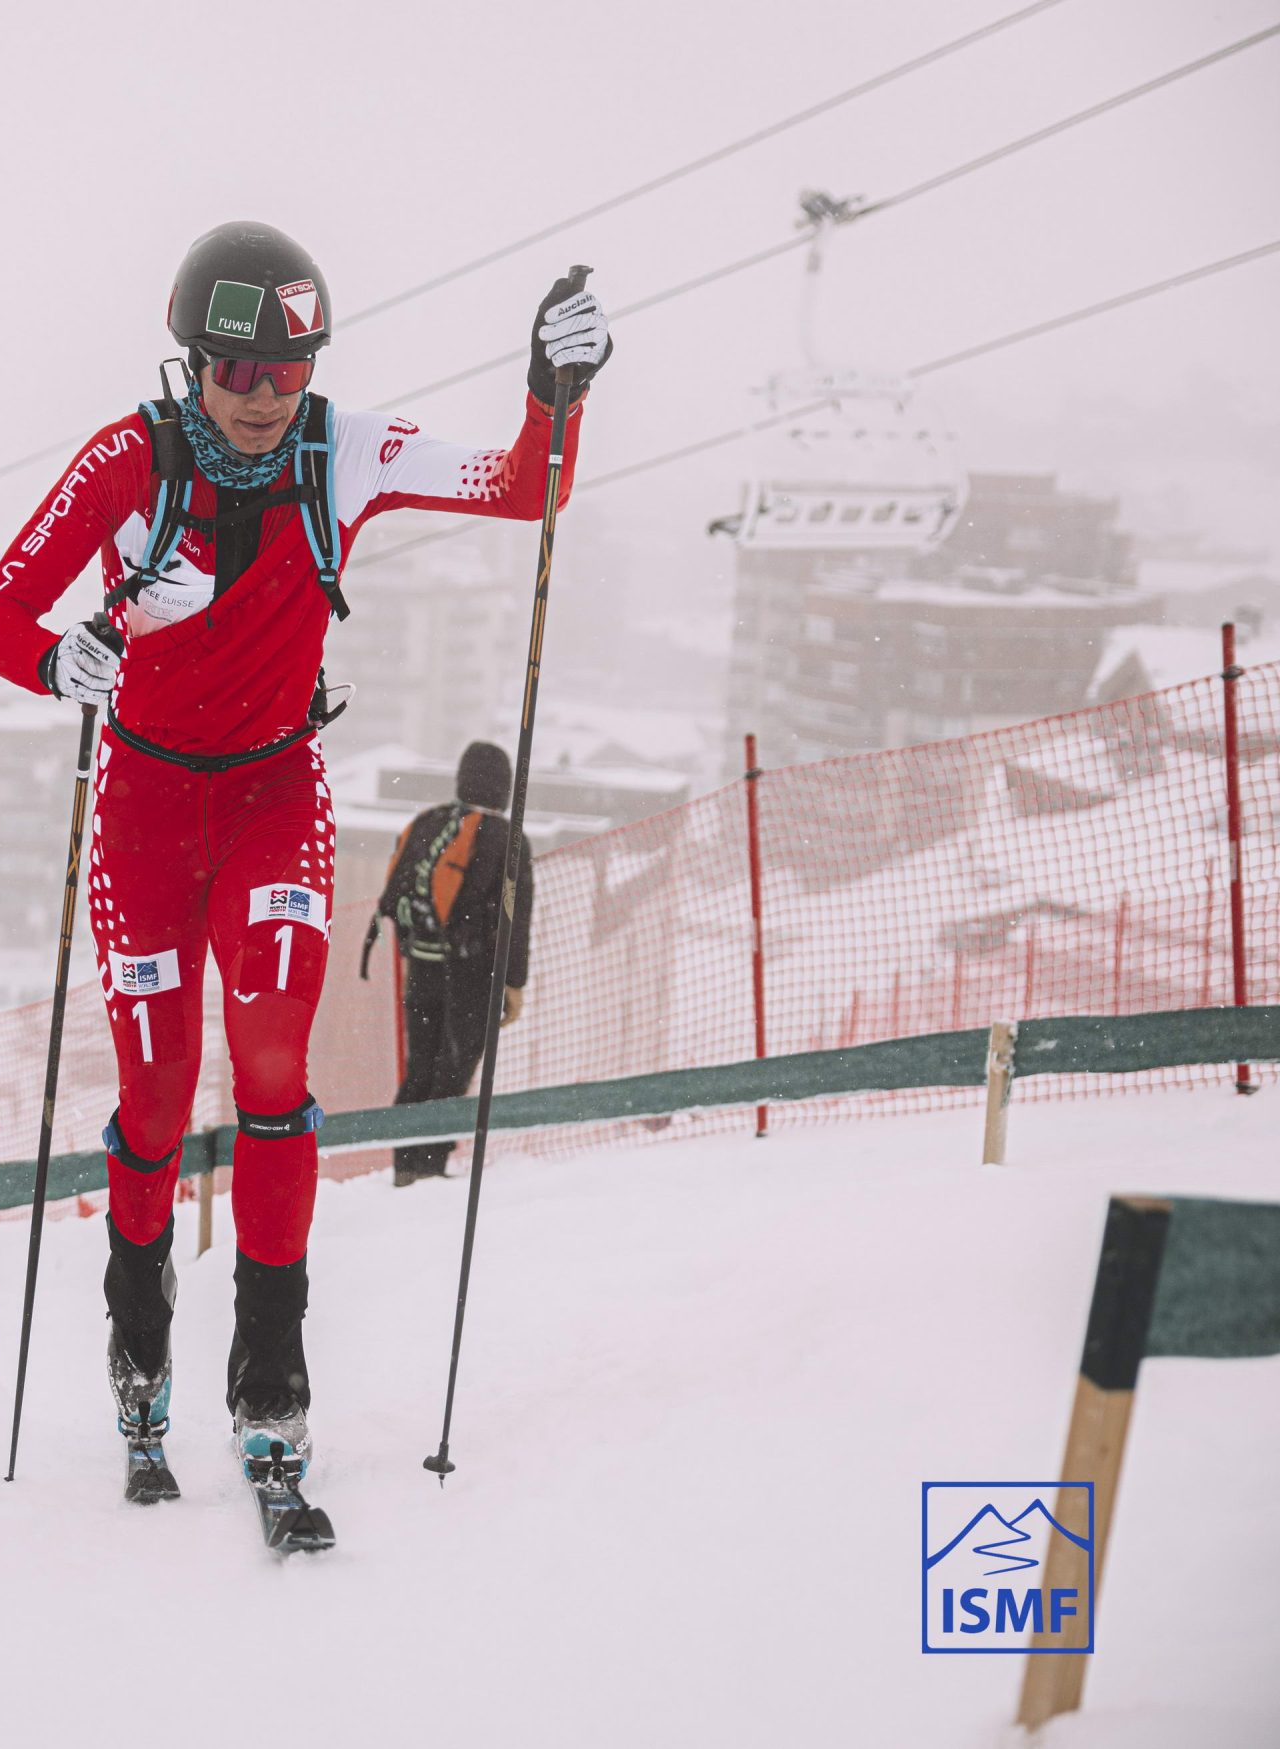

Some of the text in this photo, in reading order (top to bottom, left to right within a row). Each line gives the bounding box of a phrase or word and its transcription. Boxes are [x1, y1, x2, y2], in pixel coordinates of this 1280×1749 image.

[218, 317, 252, 333] ruwa
[21, 428, 145, 557] SPORTIVA
[161, 595, 195, 608] SUISSE
[289, 900, 309, 910] ISMF
[274, 924, 293, 991] 1
[131, 1000, 153, 1063] 1
